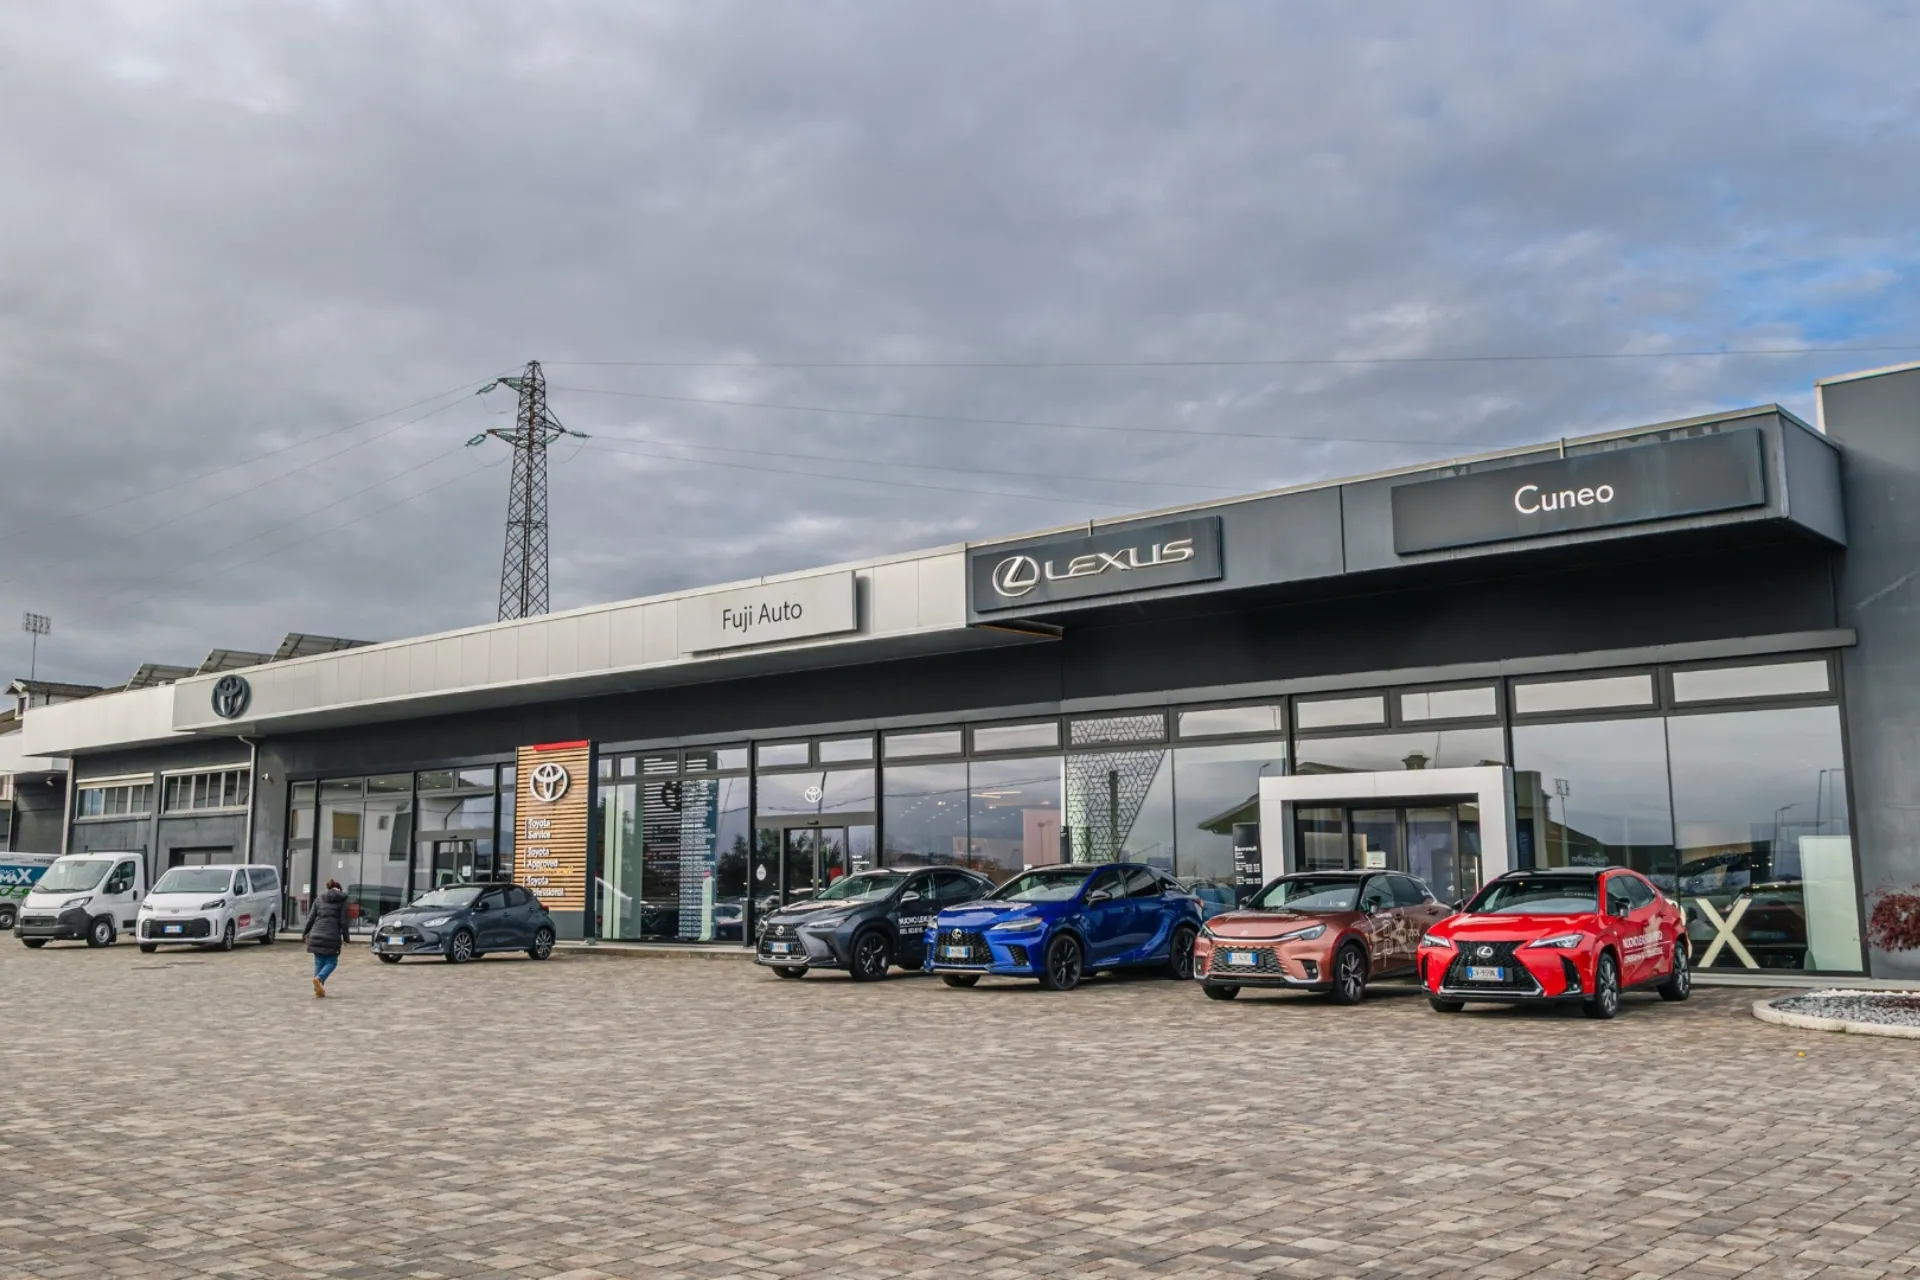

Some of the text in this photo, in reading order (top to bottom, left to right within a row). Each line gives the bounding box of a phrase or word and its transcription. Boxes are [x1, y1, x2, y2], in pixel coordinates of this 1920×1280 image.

[1514, 484, 1615, 514] Cuneo
[1044, 538, 1195, 581] LEXUS
[722, 601, 803, 633] Fuji Auto
[527, 818, 552, 830] Toyota
[527, 830, 551, 839] Service
[527, 847, 550, 858] Toyota
[526, 858, 560, 871] Approved
[526, 875, 550, 887] Toyota
[1695, 898, 1760, 969] X
